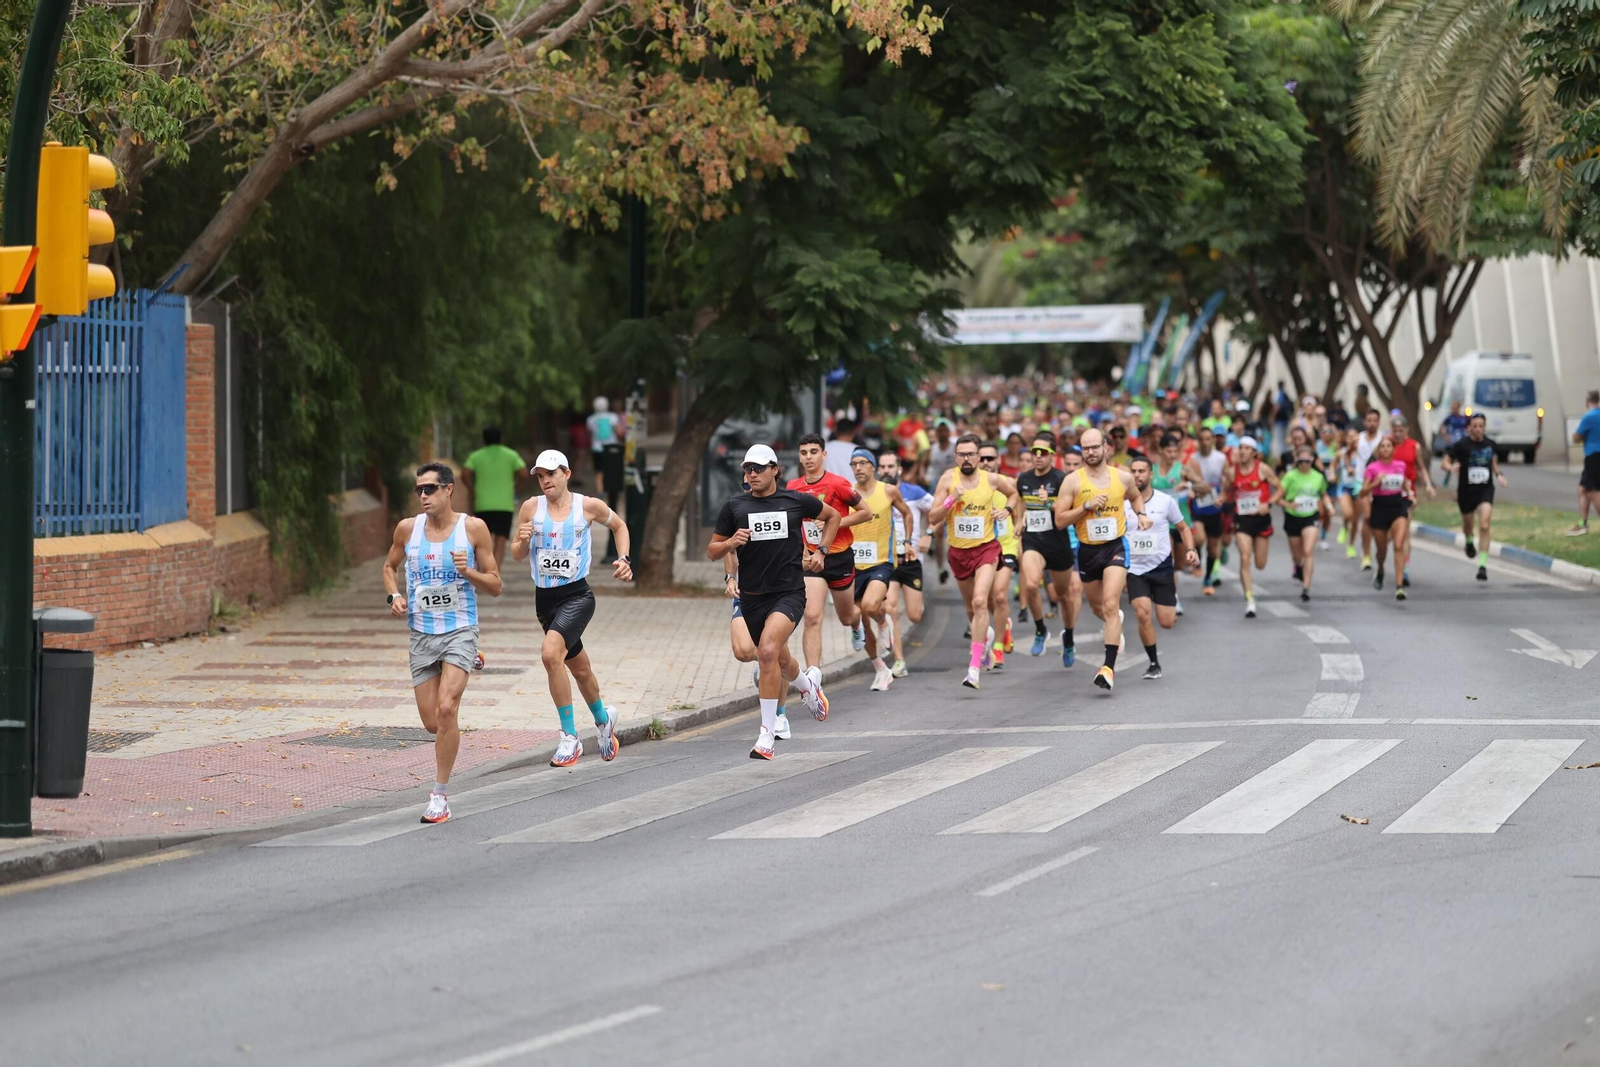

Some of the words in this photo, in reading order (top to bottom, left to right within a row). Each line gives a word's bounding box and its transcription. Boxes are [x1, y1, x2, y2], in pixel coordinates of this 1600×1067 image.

[754, 520, 781, 533] 859
[958, 523, 980, 532] 692
[1095, 525, 1109, 535] 33
[1133, 540, 1153, 549] 790
[852, 549, 872, 557] 796
[543, 558, 570, 569] 344
[421, 594, 452, 606] 125
